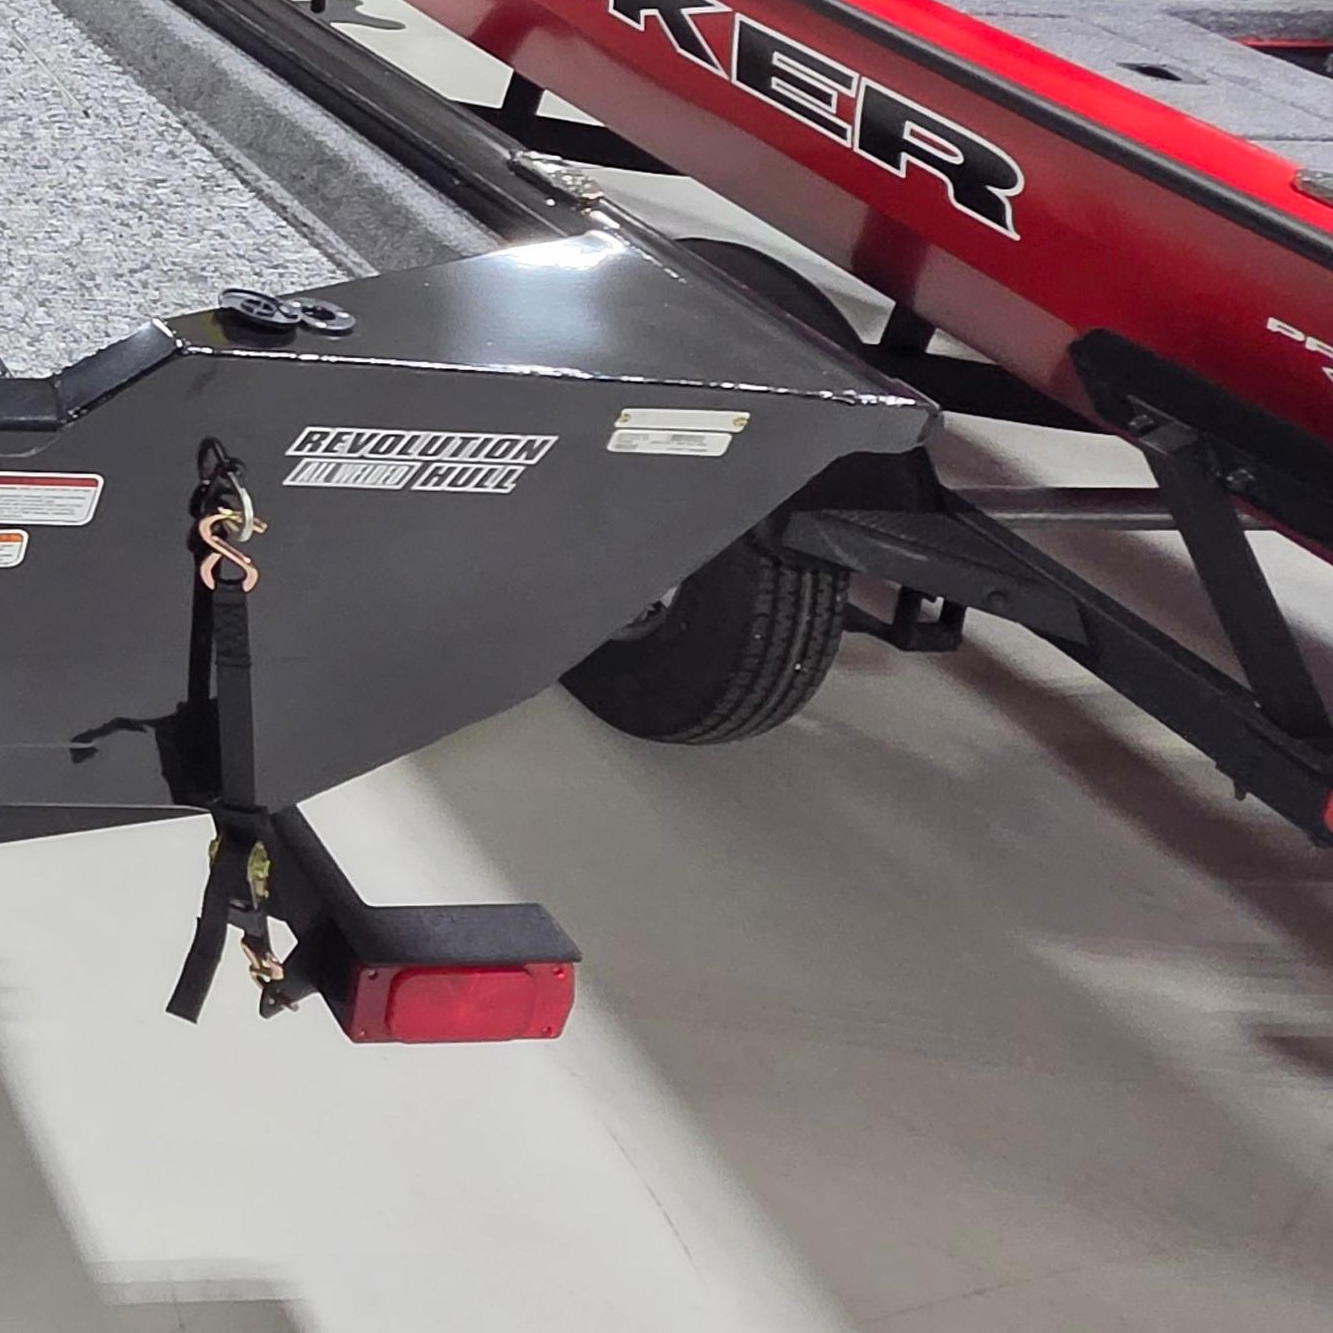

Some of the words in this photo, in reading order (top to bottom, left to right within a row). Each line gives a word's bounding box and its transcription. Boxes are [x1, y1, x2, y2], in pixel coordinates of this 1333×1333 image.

[290, 428, 554, 463] REVOLUTION
[291, 461, 337, 484] ALL
[334, 463, 413, 487] WELDED
[416, 466, 521, 491] HULL
